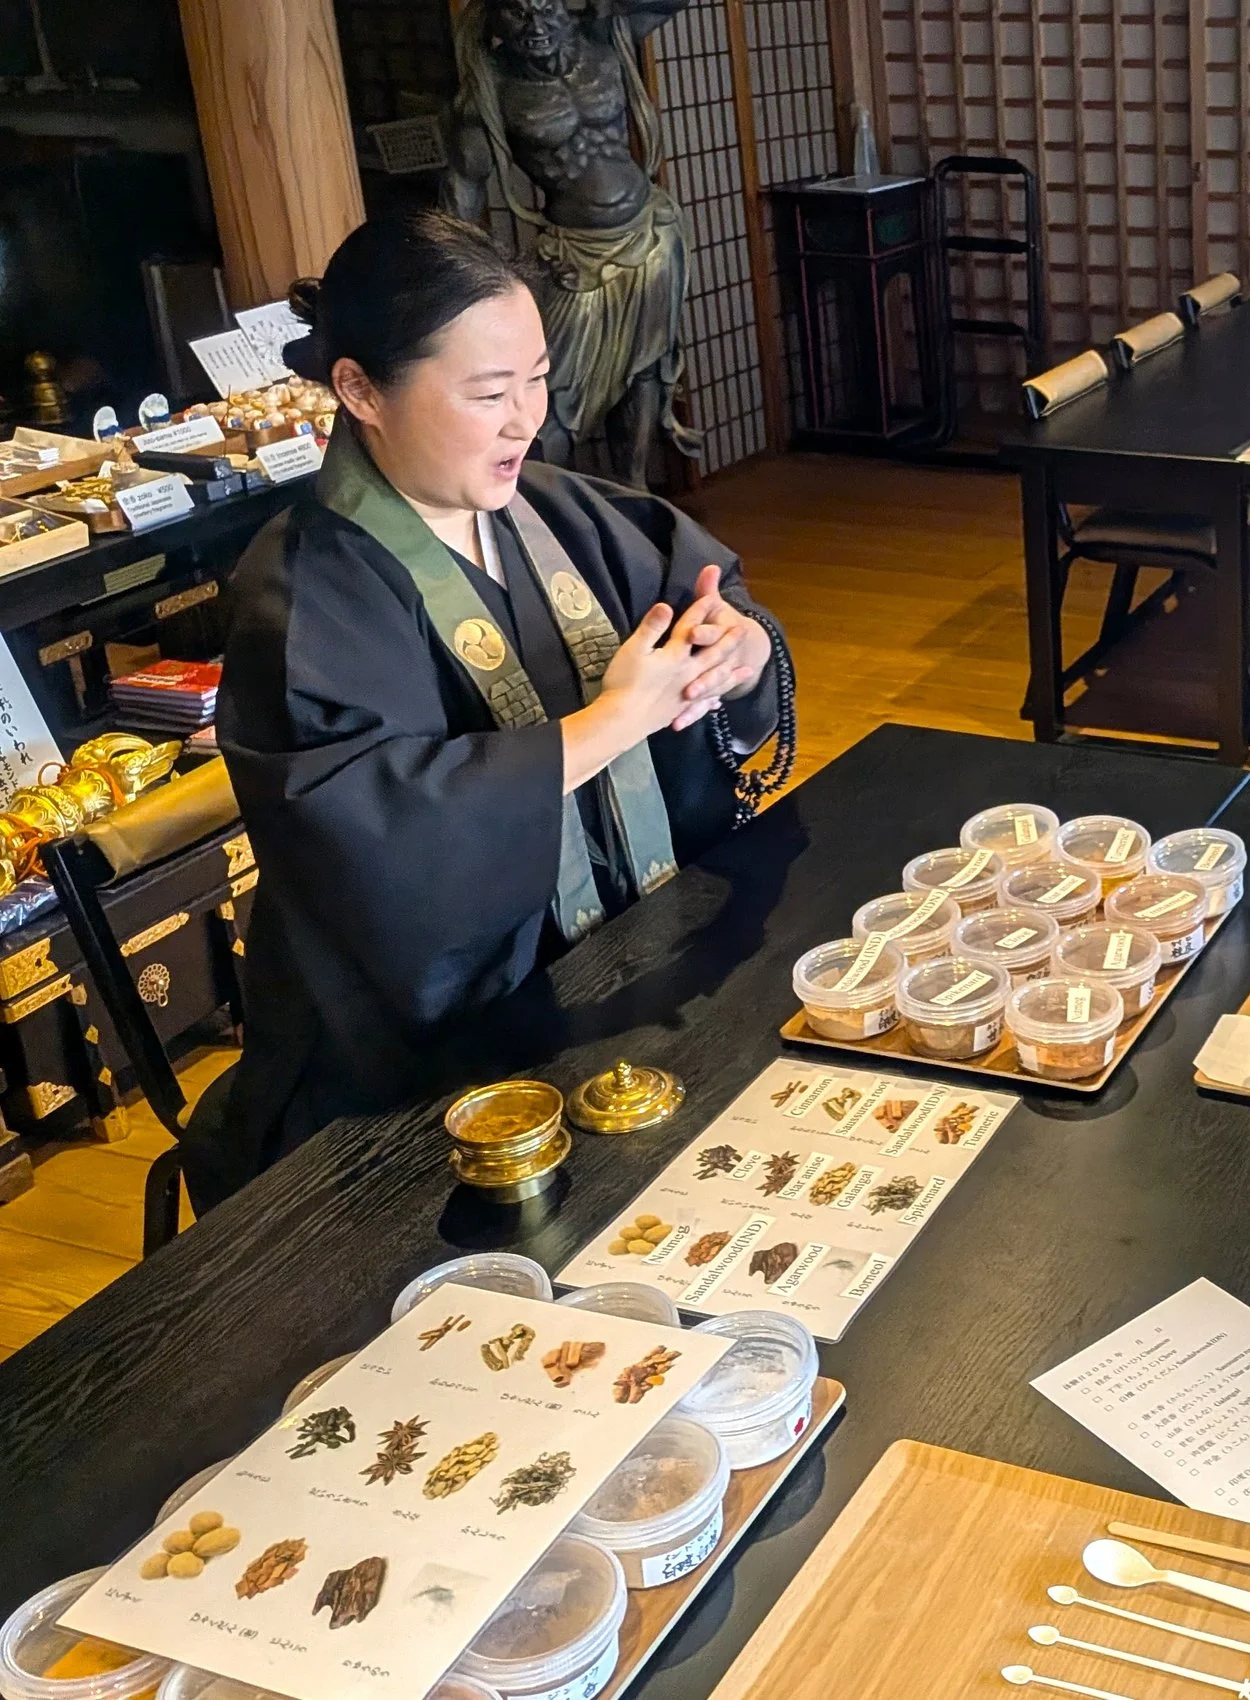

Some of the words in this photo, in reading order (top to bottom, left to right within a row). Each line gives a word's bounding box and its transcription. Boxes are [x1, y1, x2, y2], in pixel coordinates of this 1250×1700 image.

[790, 1077, 833, 1117] Cinnamon
[835, 1093, 875, 1136] Saussurea
[873, 1079, 891, 1096] root
[885, 1084, 950, 1156] Sandalwood(IDN)
[963, 1110, 999, 1148] Turmeric
[733, 1153, 762, 1179] Clove
[783, 1178, 804, 1199] Star
[803, 1154, 825, 1181] anise
[837, 1170, 875, 1209] Galangal
[904, 1177, 947, 1223] Spikenard
[651, 1223, 691, 1264] Nutmeg
[687, 1217, 770, 1303] Sandalwood(IND)
[780, 1242, 824, 1293] Agarwood
[849, 1258, 887, 1297] Borneol
[1158, 1349, 1177, 1362] Clove
[1213, 1387, 1241, 1407] Galangal
